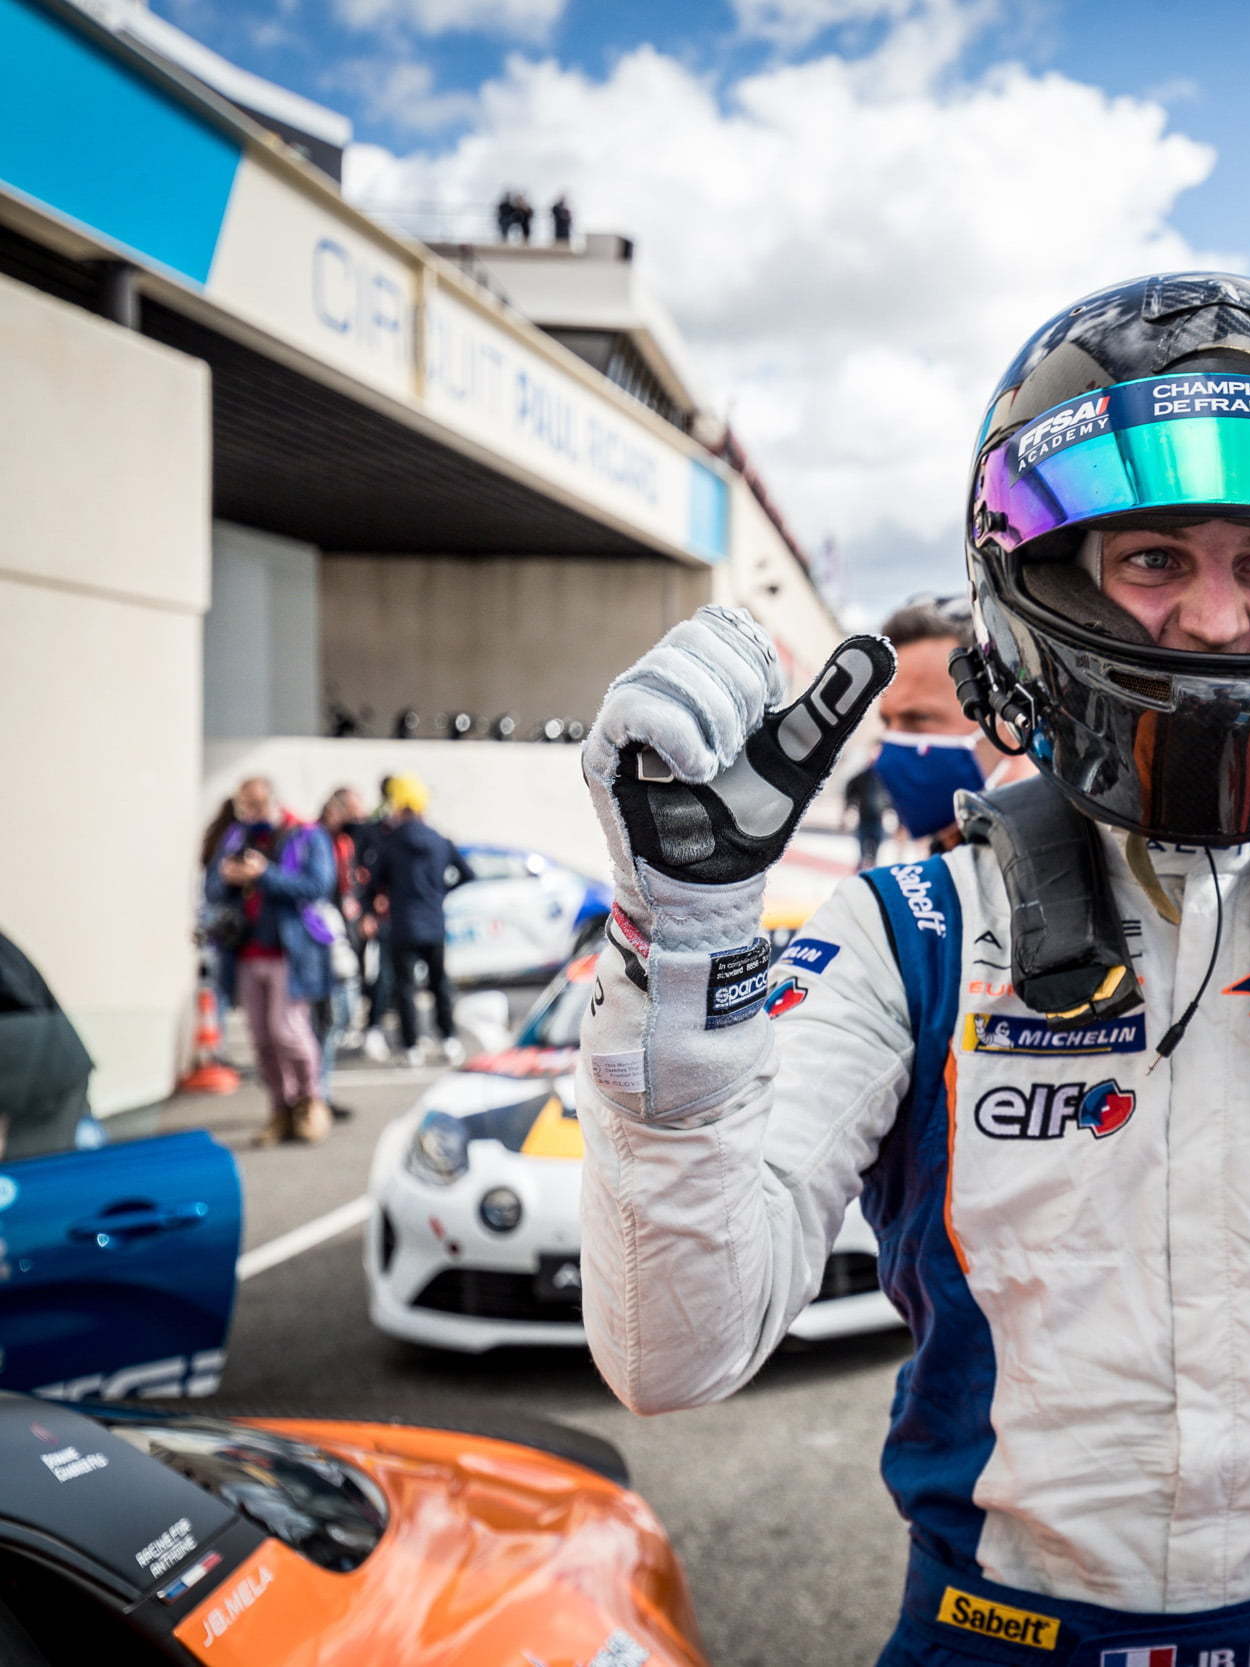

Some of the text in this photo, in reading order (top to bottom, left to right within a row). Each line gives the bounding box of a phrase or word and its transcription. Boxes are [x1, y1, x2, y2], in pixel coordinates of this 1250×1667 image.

[1018, 398, 1102, 457] FFSA
[1154, 400, 1191, 416] DE
[1018, 417, 1110, 473] ACADEMY
[890, 865, 947, 938] Sabelt
[1018, 1026, 1136, 1047] MICHELIN
[974, 1082, 1086, 1140] elf
[202, 1566, 274, 1648] JB.MELA
[951, 1596, 1050, 1645] Sabelt
